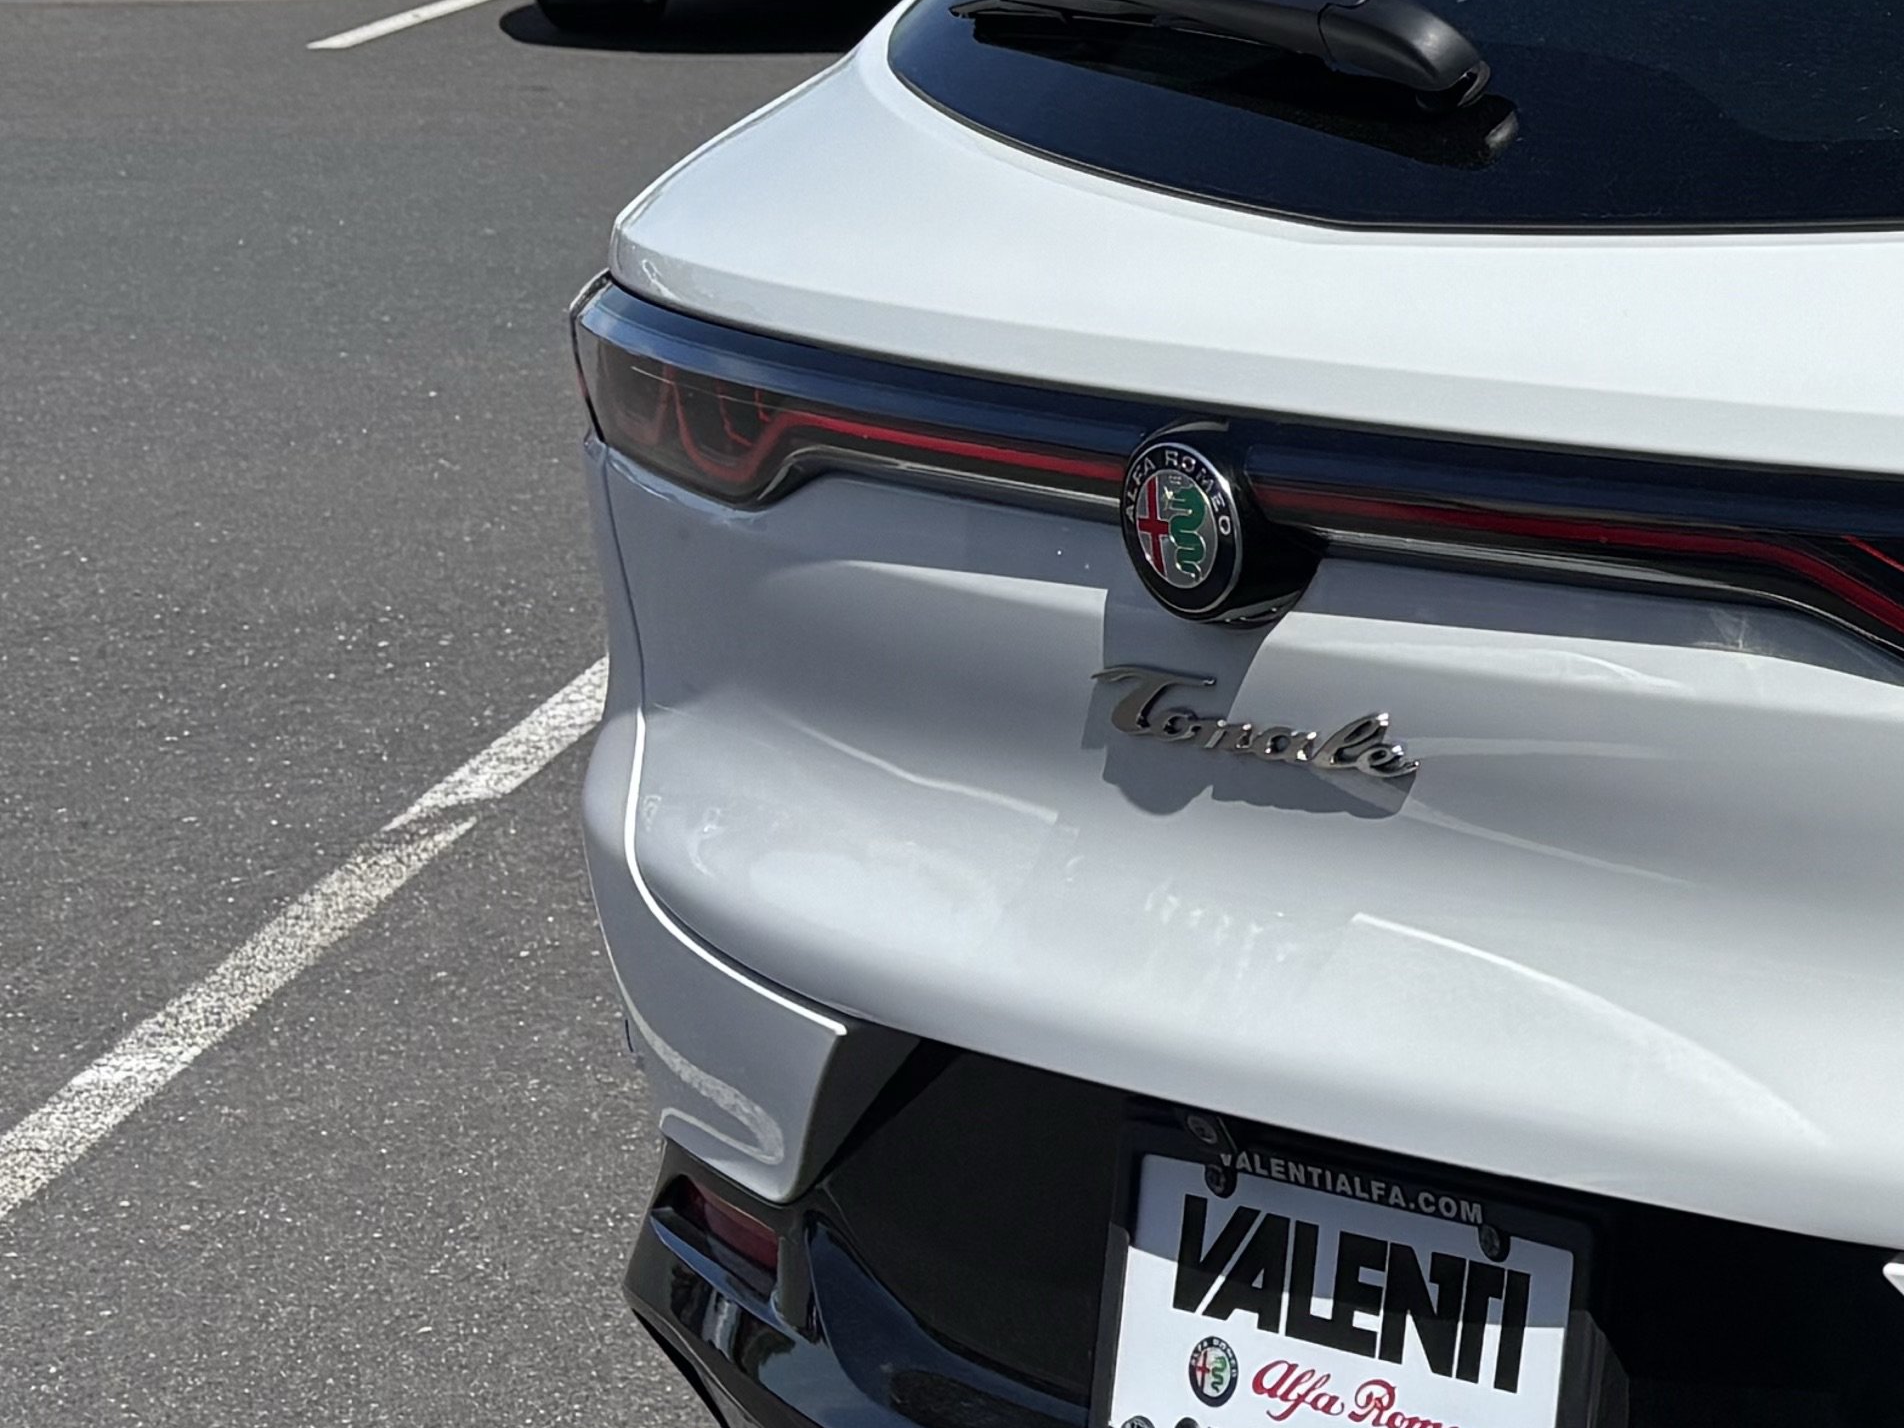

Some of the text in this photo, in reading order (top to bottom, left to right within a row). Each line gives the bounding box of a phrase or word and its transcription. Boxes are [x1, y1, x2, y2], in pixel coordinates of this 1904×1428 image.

[1125, 449, 1232, 536] ALFA ROMEO
[1219, 1152, 1485, 1226] VALENTIALFA.COM
[1171, 1193, 1532, 1394] VALENTI
[1251, 1359, 1346, 1422] Alfa
